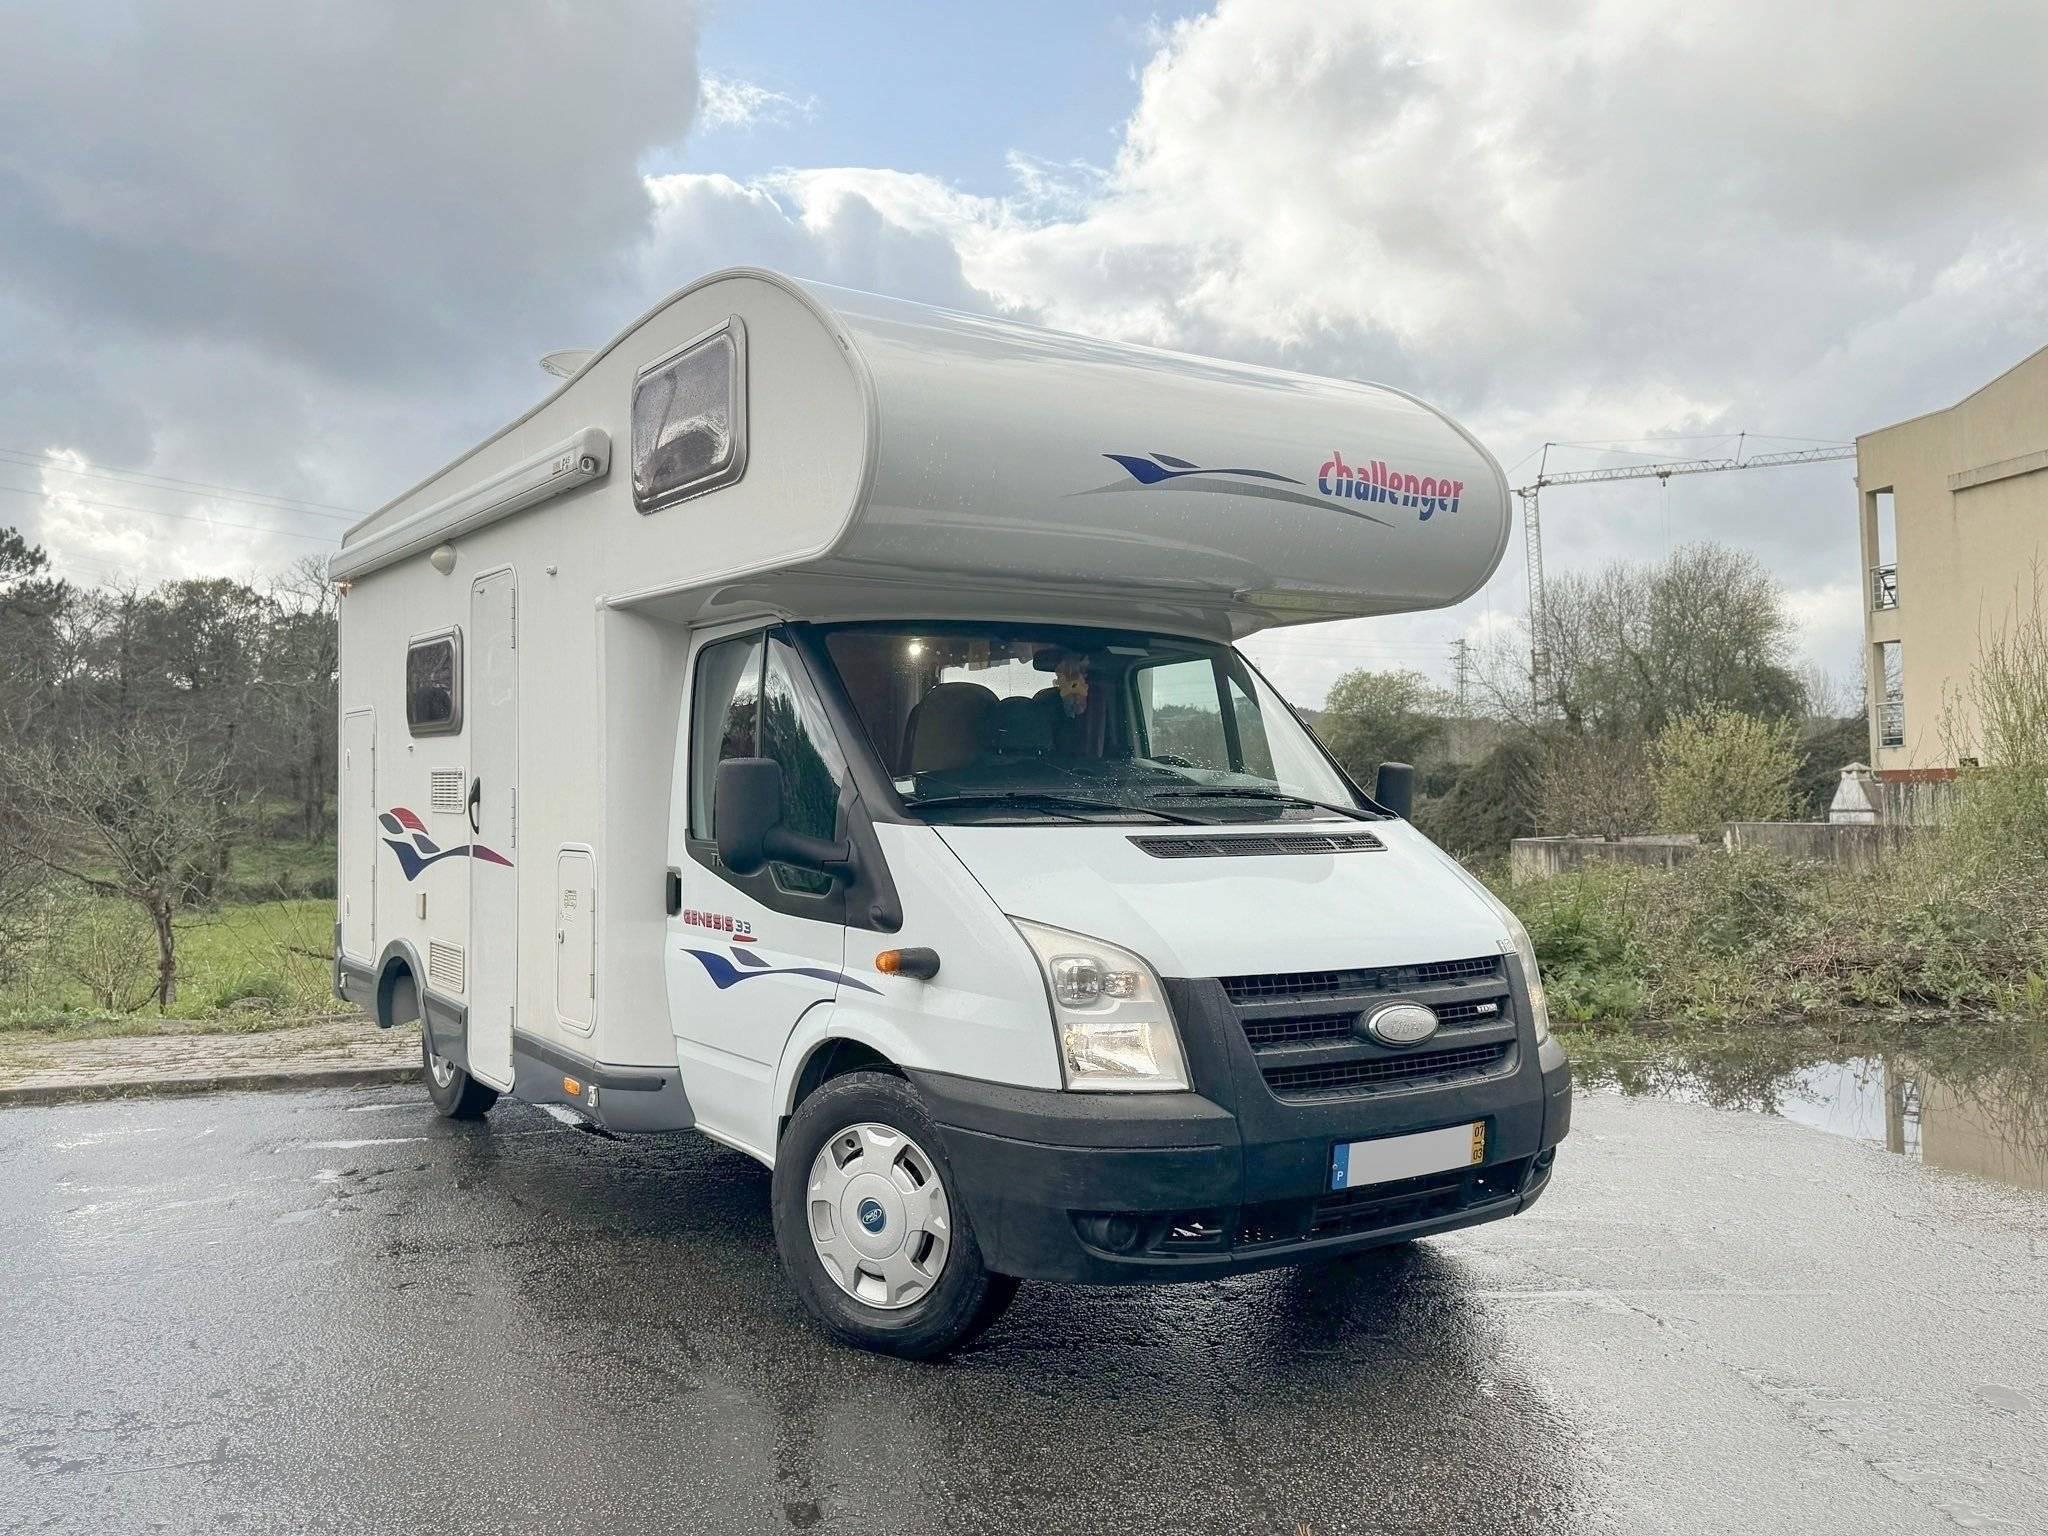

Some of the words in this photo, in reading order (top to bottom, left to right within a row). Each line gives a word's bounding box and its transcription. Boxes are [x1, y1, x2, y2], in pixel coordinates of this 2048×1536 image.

[683, 909, 733, 932] GENESIS
[735, 919, 752, 934] 33
[1474, 1125, 1484, 1137] 07
[1472, 1149, 1483, 1160] 03
[1336, 1171, 1344, 1181] P
